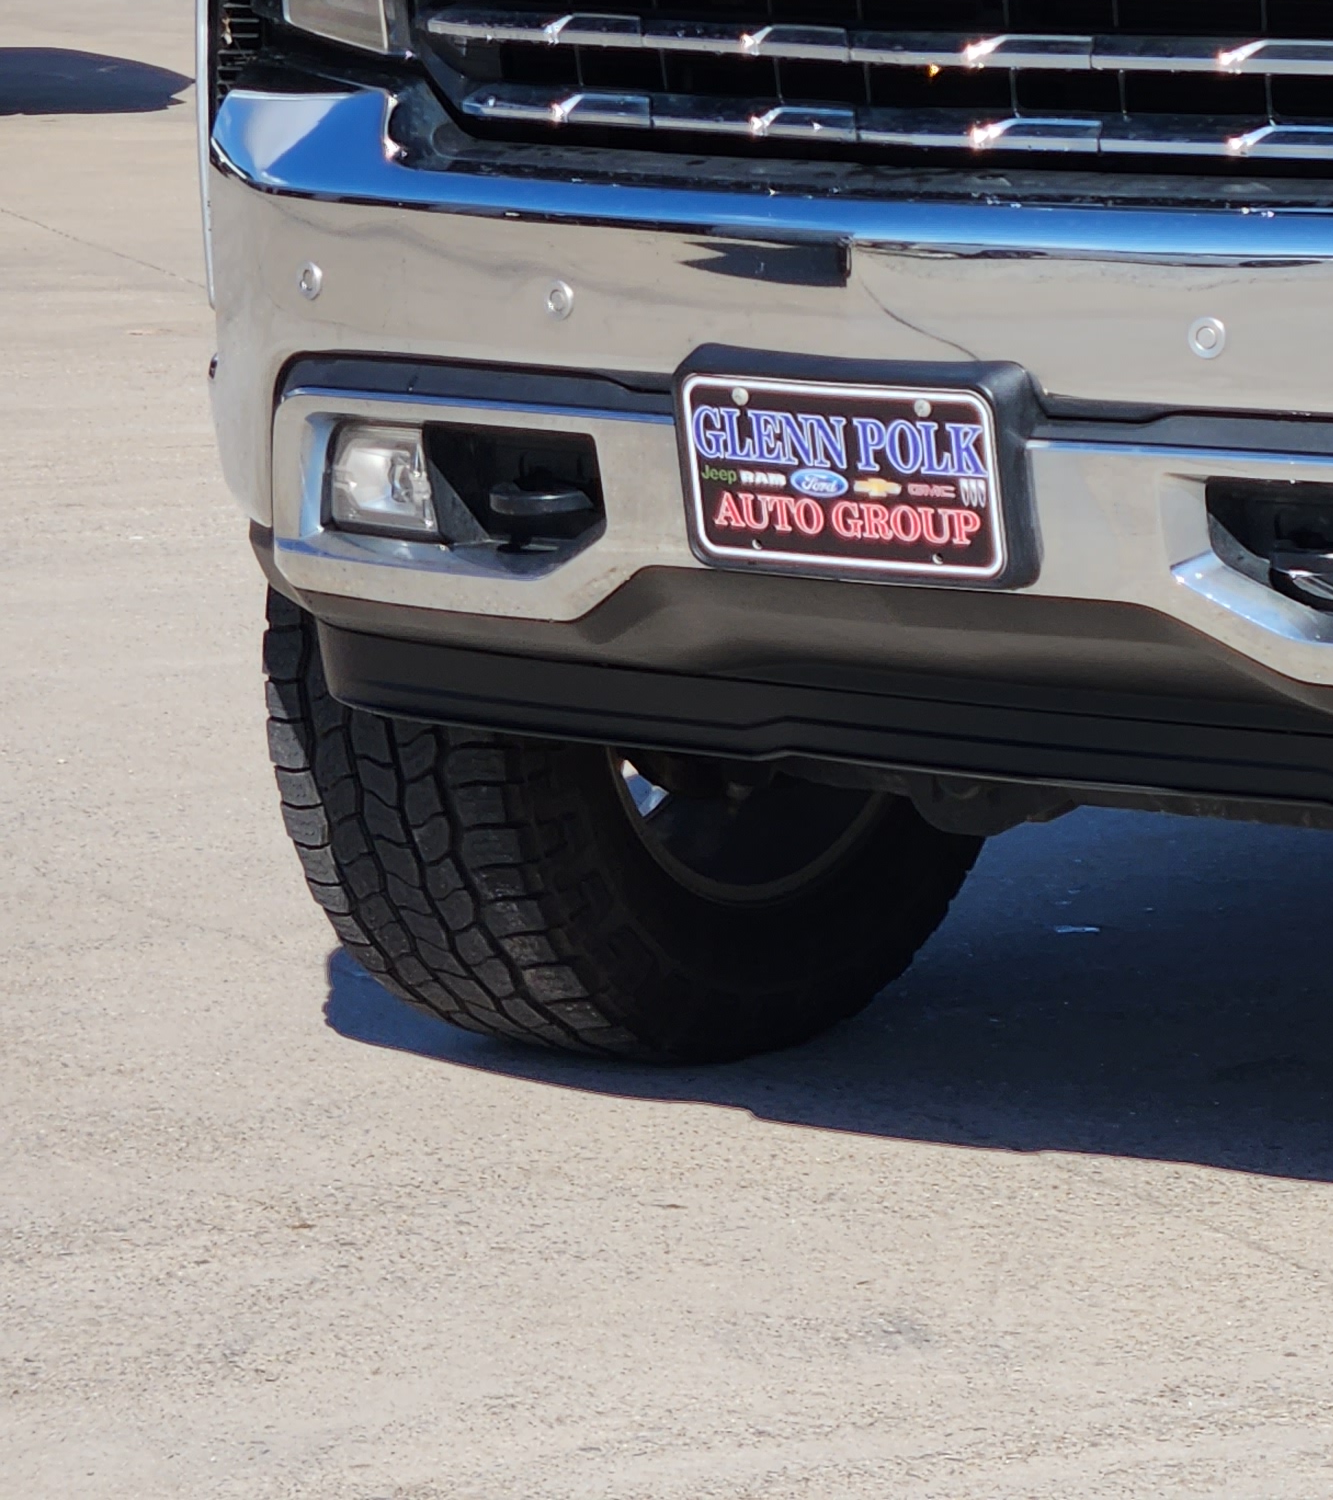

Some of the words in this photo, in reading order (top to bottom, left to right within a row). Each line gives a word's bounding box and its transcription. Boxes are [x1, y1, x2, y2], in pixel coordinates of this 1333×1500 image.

[692, 405, 847, 471] GLENN
[853, 417, 988, 478] POLK
[701, 464, 737, 485] Jeep
[740, 470, 787, 487] RAM
[801, 474, 838, 493] Ford
[907, 483, 957, 498] GMC
[715, 491, 824, 536] AUTO
[832, 502, 981, 546] GROUP
